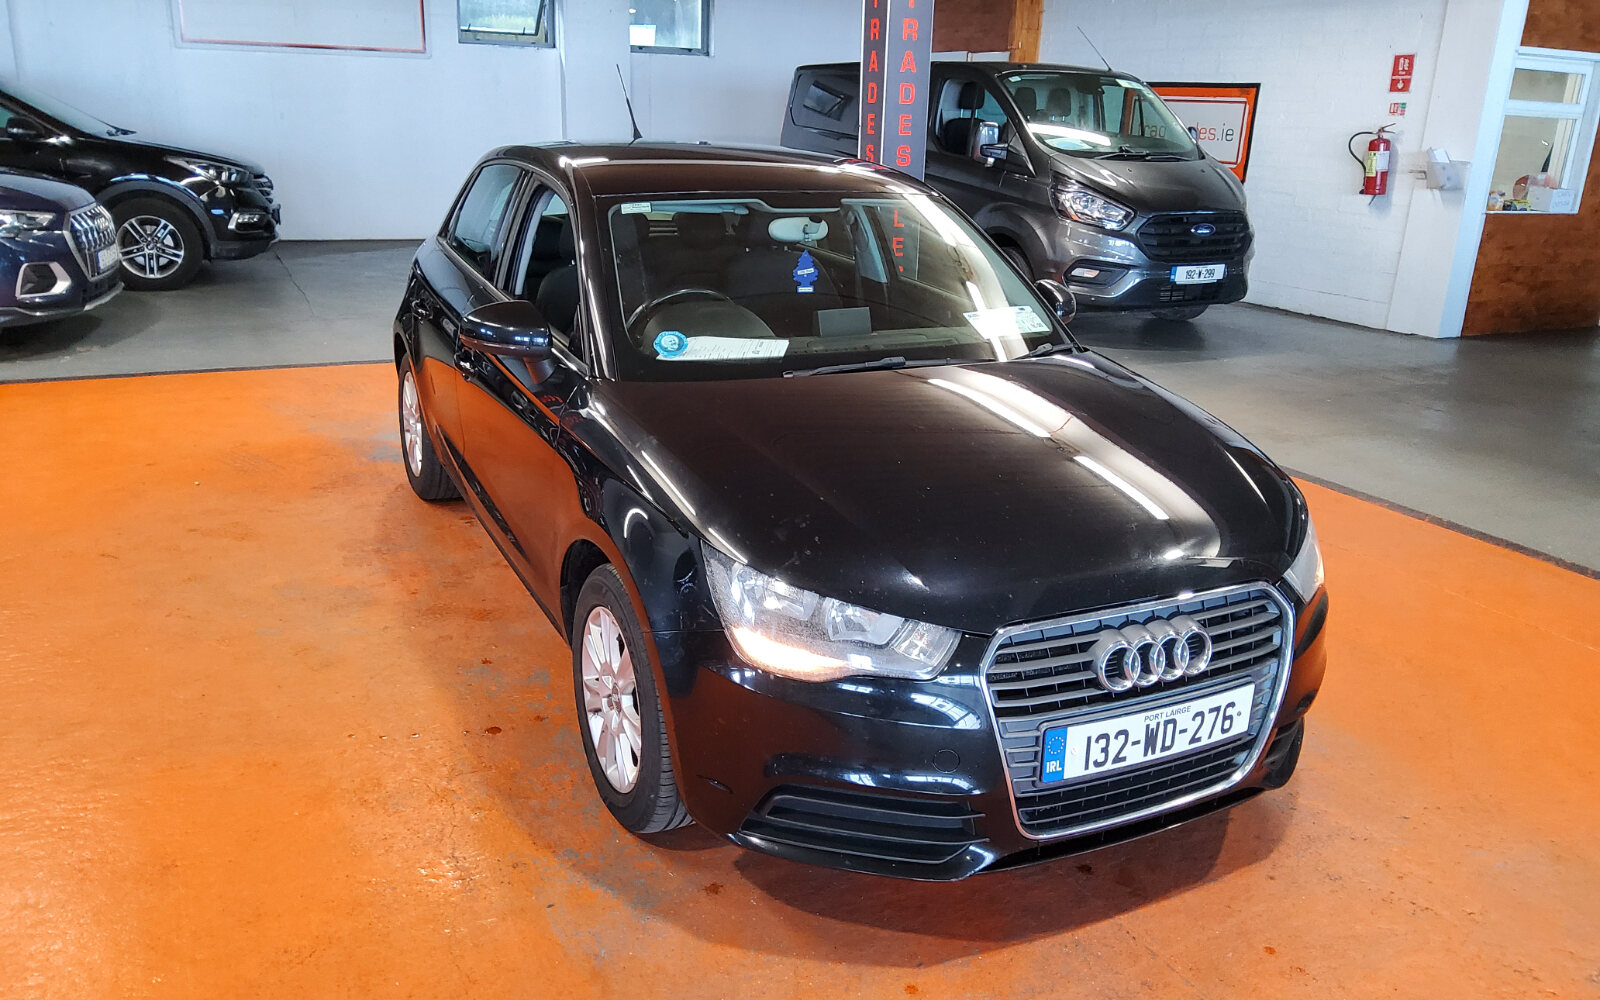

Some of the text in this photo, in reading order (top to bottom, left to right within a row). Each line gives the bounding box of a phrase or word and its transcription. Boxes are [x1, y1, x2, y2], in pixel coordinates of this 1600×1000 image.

[1144, 712, 1164, 723] PORT
[1084, 701, 1236, 771] 132-WD-276
[1046, 760, 1062, 773] IRL
